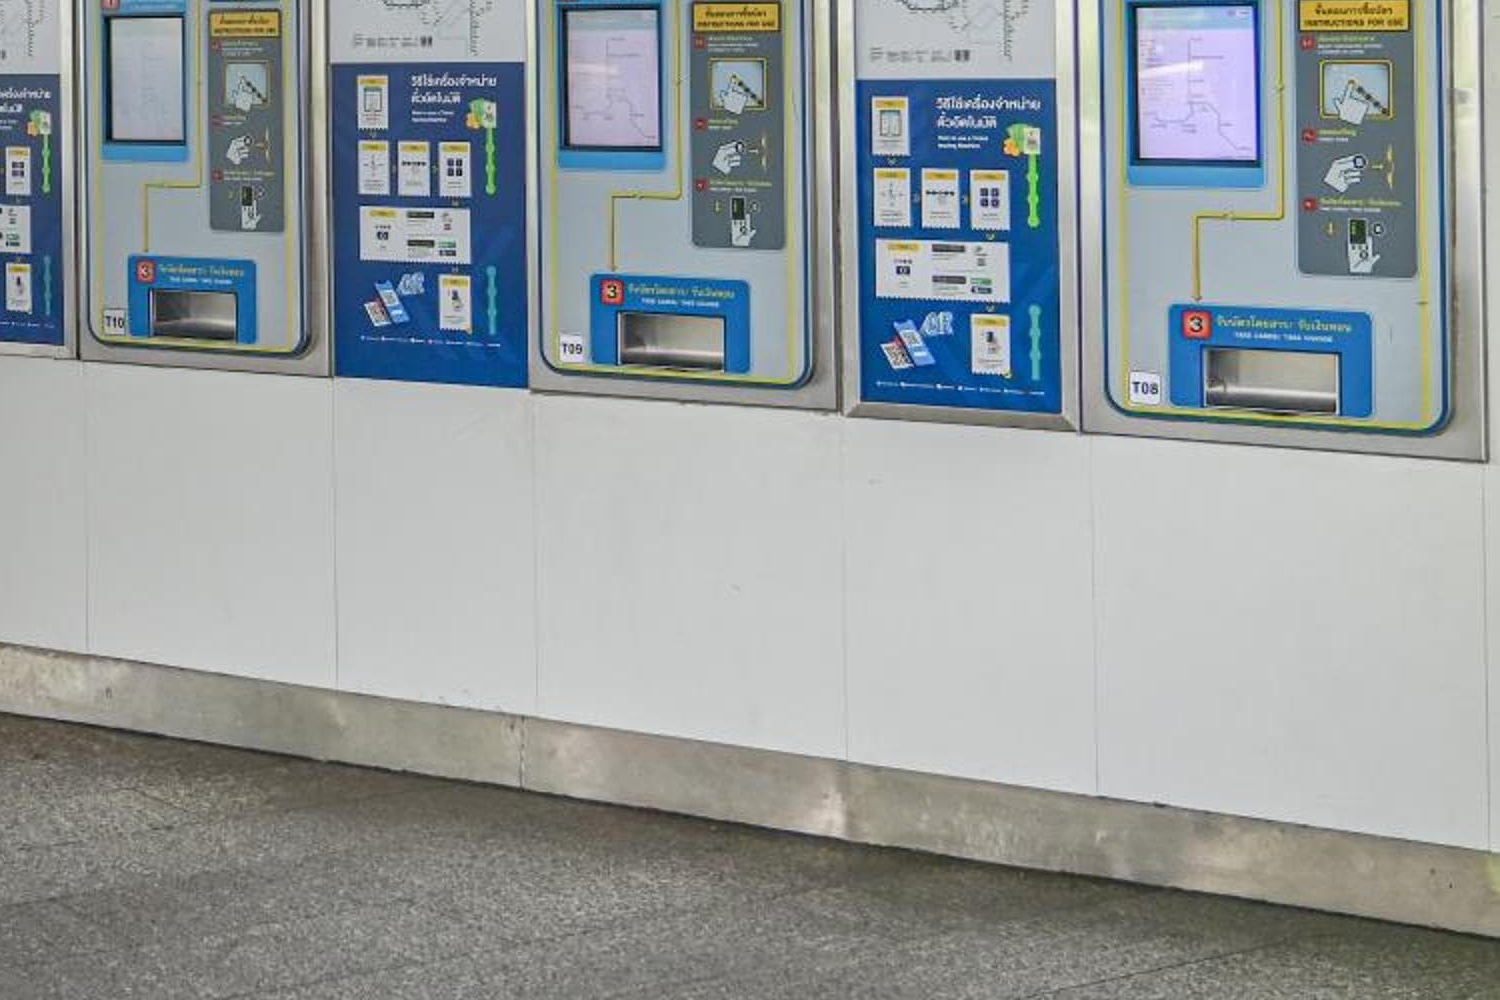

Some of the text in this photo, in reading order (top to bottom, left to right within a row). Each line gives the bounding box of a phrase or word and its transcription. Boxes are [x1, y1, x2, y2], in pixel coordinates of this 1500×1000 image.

[606, 284, 618, 299] 3
[105, 315, 125, 329] T10
[1188, 315, 1204, 333] 3
[562, 342, 583, 356] T09
[1132, 380, 1160, 397] T08
